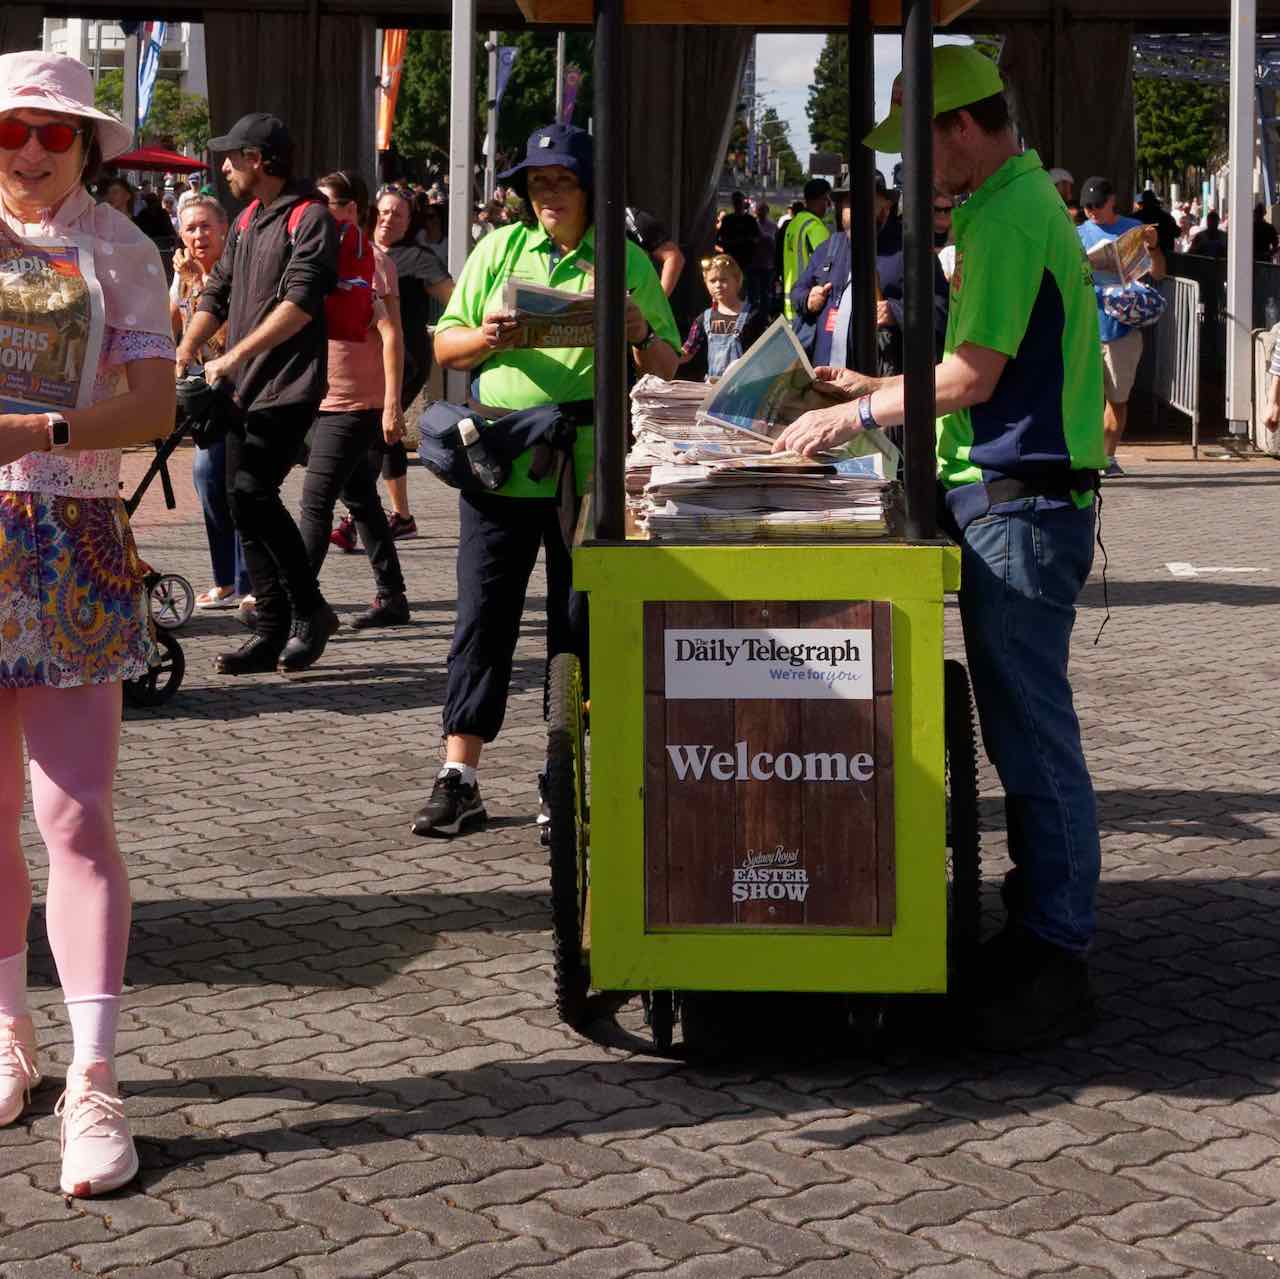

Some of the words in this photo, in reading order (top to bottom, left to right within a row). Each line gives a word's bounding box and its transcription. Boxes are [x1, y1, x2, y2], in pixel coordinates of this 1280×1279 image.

[674, 638, 740, 666] Daily
[742, 637, 860, 667] Telegraph
[769, 669, 805, 681] We're
[807, 668, 827, 681] for
[826, 670, 863, 689] you
[665, 740, 875, 782] Welcome
[742, 849, 776, 868] Sydney
[774, 845, 800, 866] Royal
[733, 869, 808, 882] EASTER
[732, 883, 809, 903] SHOW
